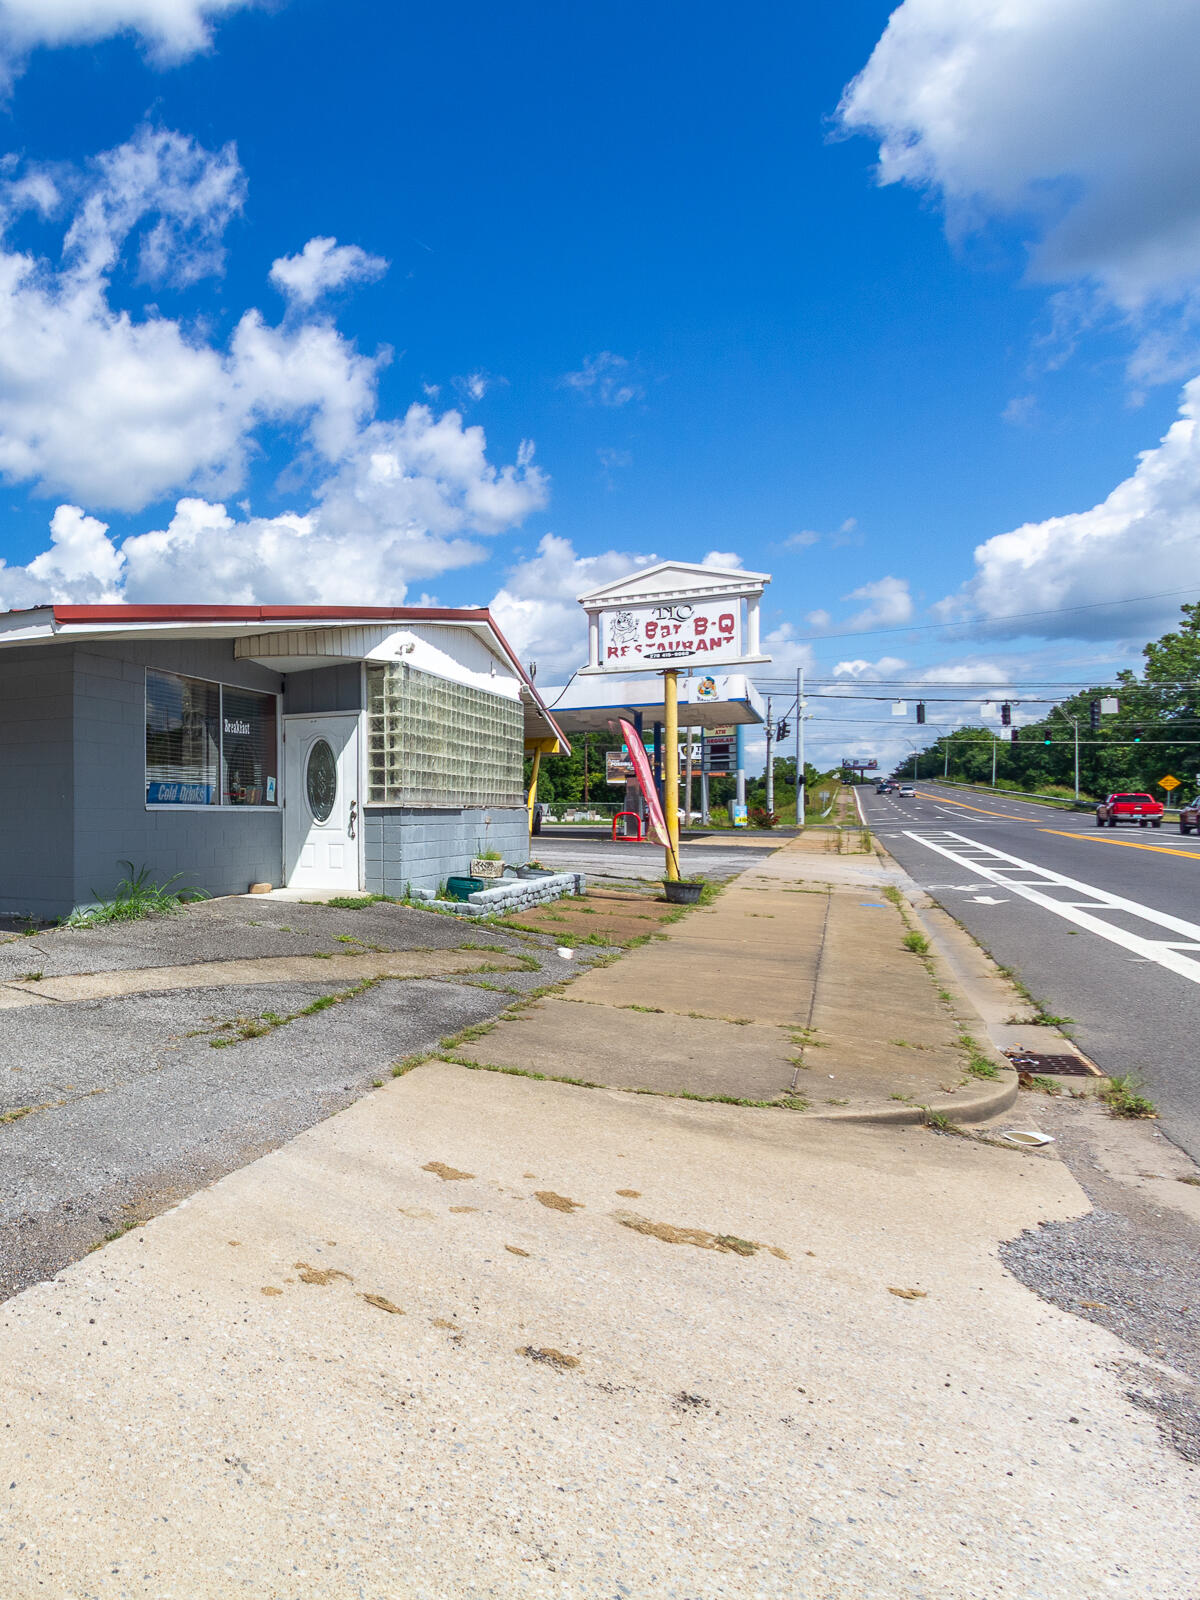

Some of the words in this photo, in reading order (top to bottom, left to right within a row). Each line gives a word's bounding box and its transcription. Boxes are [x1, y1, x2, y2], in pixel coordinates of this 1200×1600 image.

[651, 605, 695, 622] TLC
[645, 621, 681, 639] Bar
[693, 613, 735, 635] B-Q
[224, 719, 250, 735] Breakfast
[158, 784, 179, 801] Cold
[179, 785, 205, 802] Drinks
[268, 781, 274, 791] A
